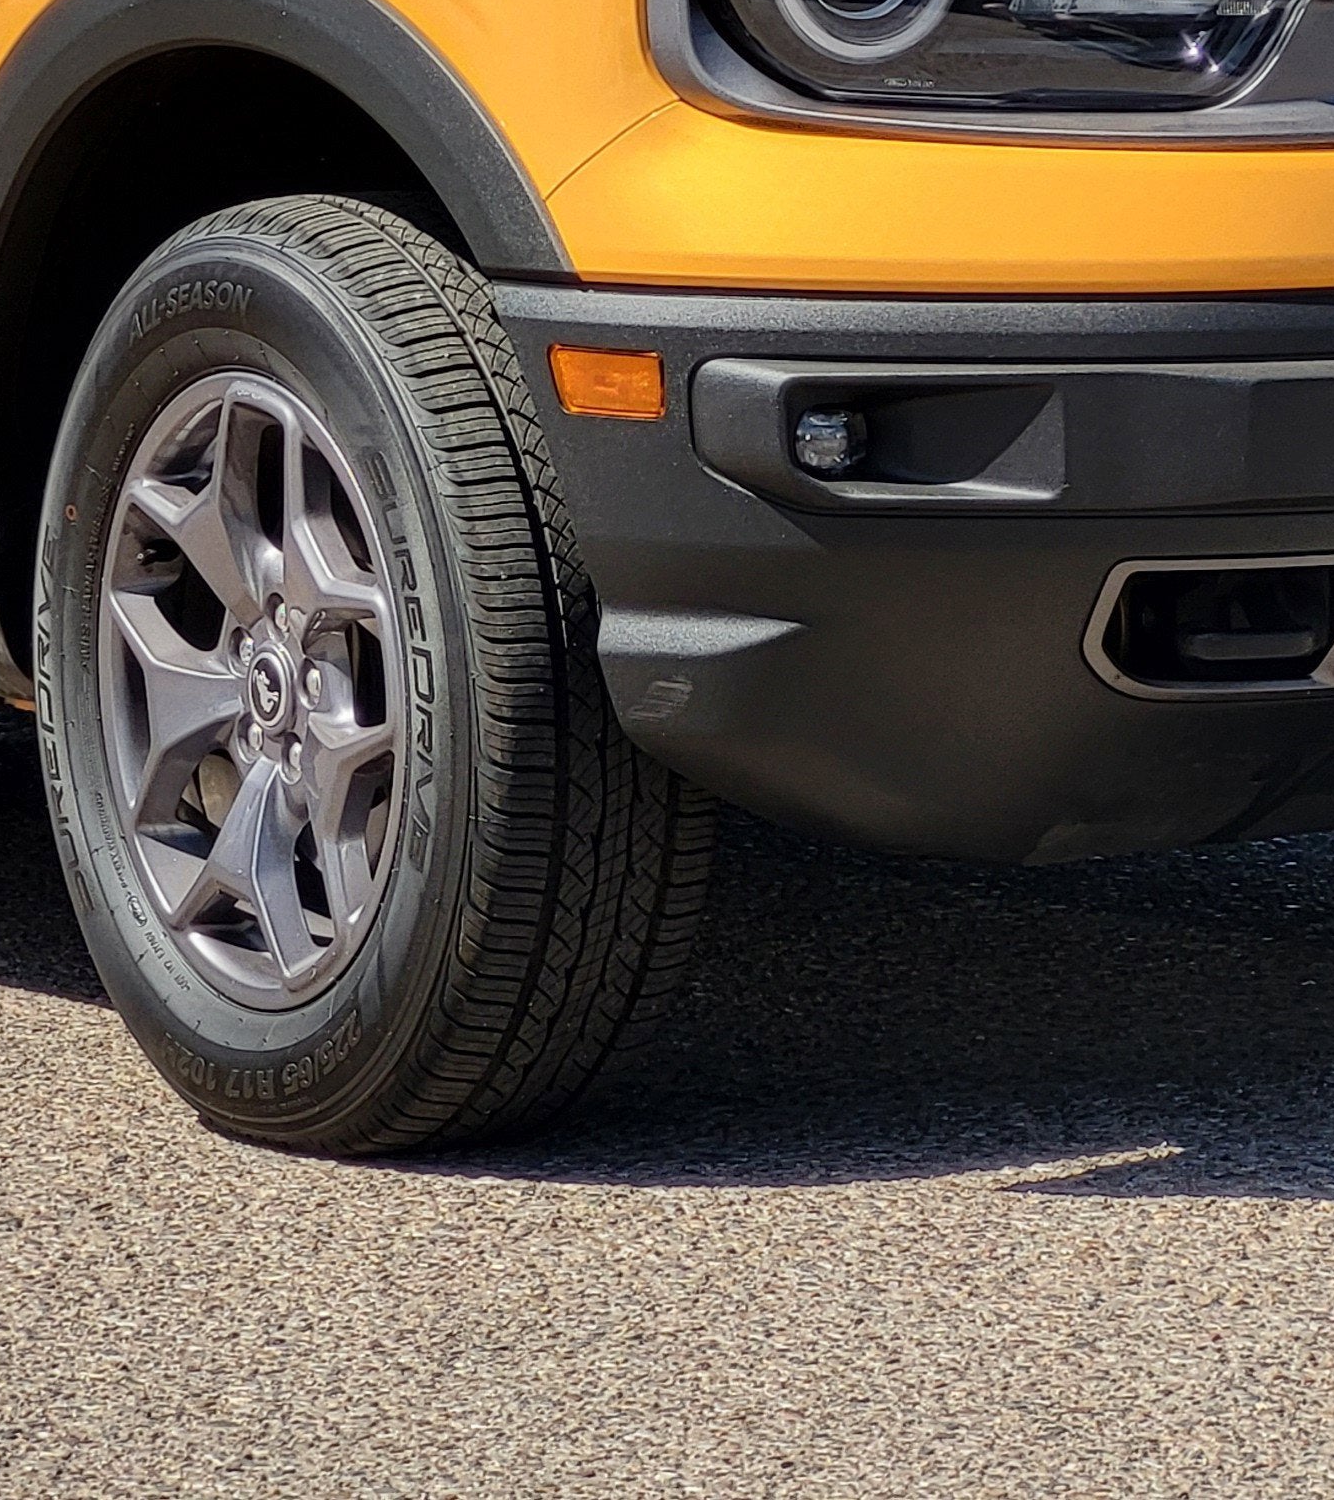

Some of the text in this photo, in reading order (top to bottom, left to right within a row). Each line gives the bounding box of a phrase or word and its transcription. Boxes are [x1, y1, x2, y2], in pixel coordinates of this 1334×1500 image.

[128, 278, 254, 348] ALL-SEASON
[367, 450, 437, 874] SUREDRIVE
[224, 1068, 276, 1100] R17
